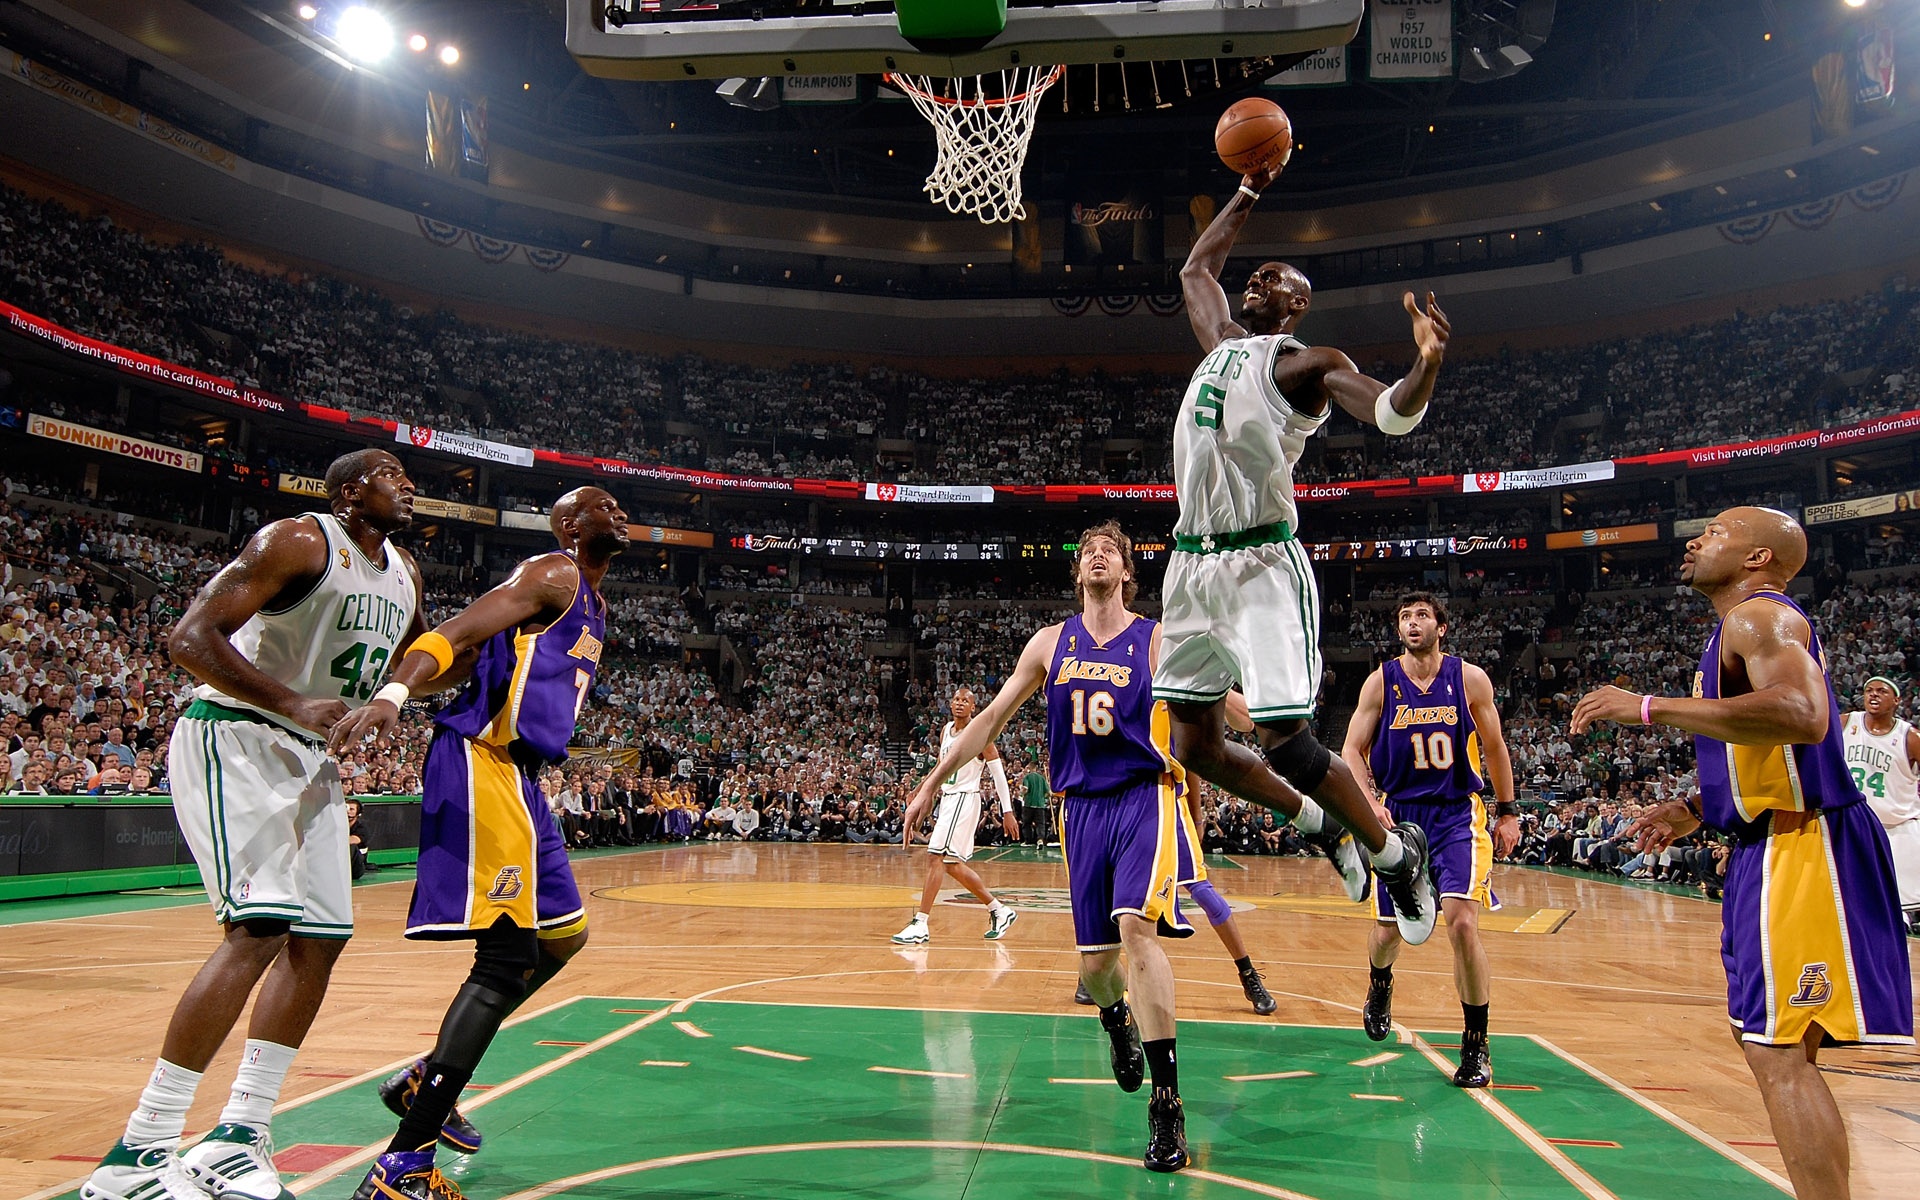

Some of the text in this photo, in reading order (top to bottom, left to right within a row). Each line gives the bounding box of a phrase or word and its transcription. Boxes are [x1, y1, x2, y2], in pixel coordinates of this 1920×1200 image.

[1399, 22, 1424, 35] 1957
[1390, 36, 1432, 49] WORLD
[1376, 51, 1447, 65] CHAMPIONS
[787, 76, 852, 88] CHAMPIONS
[1079, 202, 1153, 227] Finals
[9, 311, 285, 412] The most important name on the card isn't ours. It's yours.
[1194, 382, 1227, 430] 5
[45, 422, 118, 451] DUNKIN'
[118, 439, 183, 467] DONUTS
[434, 431, 510, 462] Harvard Pilgrim
[1691, 450, 1716, 463] Visit
[1717, 435, 1818, 460] harvardpilgrim.org
[1818, 432, 1834, 444] for
[1836, 426, 1866, 441] more
[602, 463, 793, 491] Visit harvardpilgrim.org for more information.
[1503, 470, 1588, 483] Harvard Pilgrim
[900, 486, 938, 499] Harvard
[938, 490, 971, 501] Pilgrim
[1102, 488, 1123, 499] You
[1125, 487, 1154, 499] don't
[1155, 489, 1174, 499] see
[1310, 486, 1350, 498] doctor.
[1807, 503, 1846, 516] SPORTS
[1834, 509, 1860, 520] DESK
[730, 537, 744, 548] 15
[750, 534, 800, 552] Finals
[1134, 543, 1166, 551] LAKERS
[1314, 543, 1331, 551] 3PT
[1374, 541, 1391, 549] STL
[1399, 539, 1416, 547] AST
[1426, 538, 1444, 546] REB
[1455, 535, 1511, 555] Finals
[1510, 537, 1528, 550] 15
[1600, 531, 1619, 541] at&t
[830, 547, 836, 555] 1
[854, 548, 860, 556] 1
[1142, 551, 1155, 560] 10
[1378, 550, 1385, 558] 2
[1404, 549, 1411, 557] 4
[1431, 547, 1438, 555] 2
[337, 593, 404, 646] CELTICS
[330, 641, 389, 700] 43
[1054, 656, 1132, 688] LAKERS
[574, 667, 591, 721] 7
[1071, 689, 1115, 736] 16
[1389, 704, 1458, 730] LAKERS
[1411, 731, 1454, 770] 10
[1847, 744, 1892, 773] CELTICS
[1850, 766, 1885, 798] 34
[116, 833, 138, 844] abc
[141, 826, 174, 846] Home
